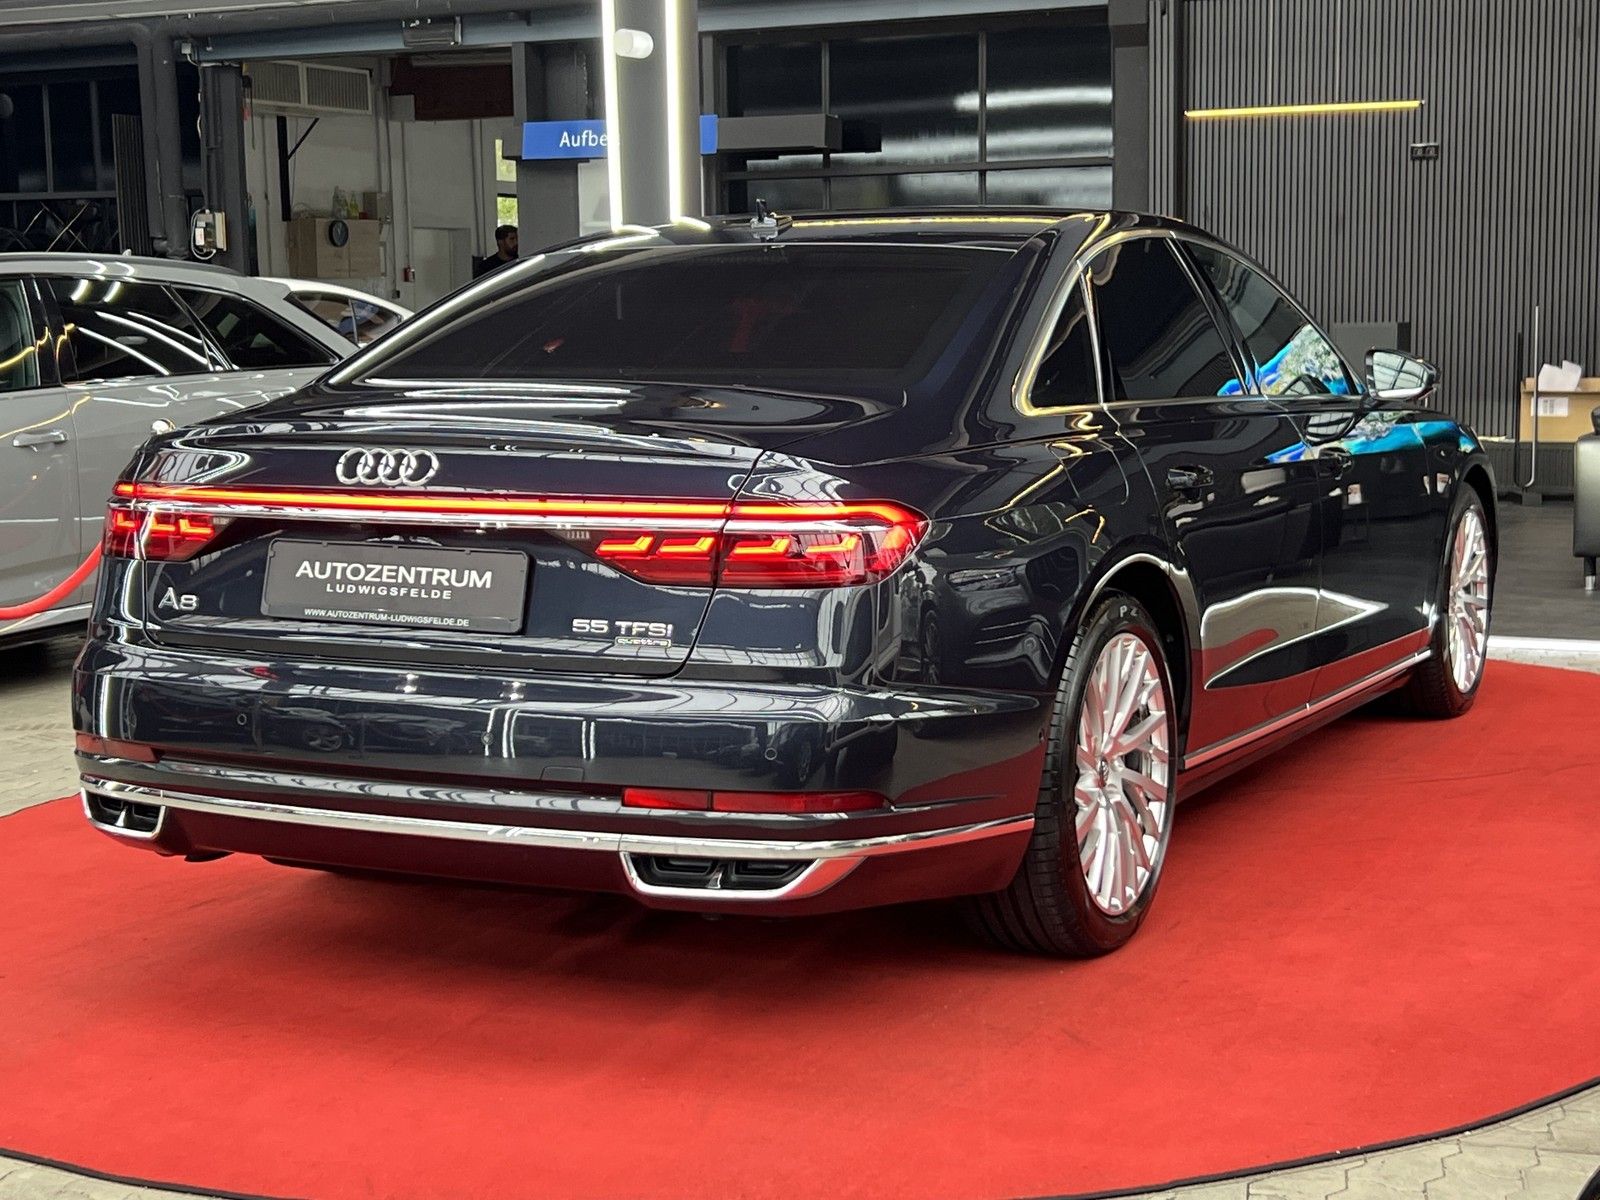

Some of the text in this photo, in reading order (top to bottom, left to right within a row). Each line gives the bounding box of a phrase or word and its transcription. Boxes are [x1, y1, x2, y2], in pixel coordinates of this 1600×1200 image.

[295, 560, 493, 589] AUTOZENTRUM
[158, 586, 197, 611] A8
[326, 583, 452, 600] LUDWIGSFELDE
[304, 608, 470, 627] WWW.AUTOZENTRUM-LUDWIGSFELDE.DE
[572, 618, 674, 638] 55 TFSI
